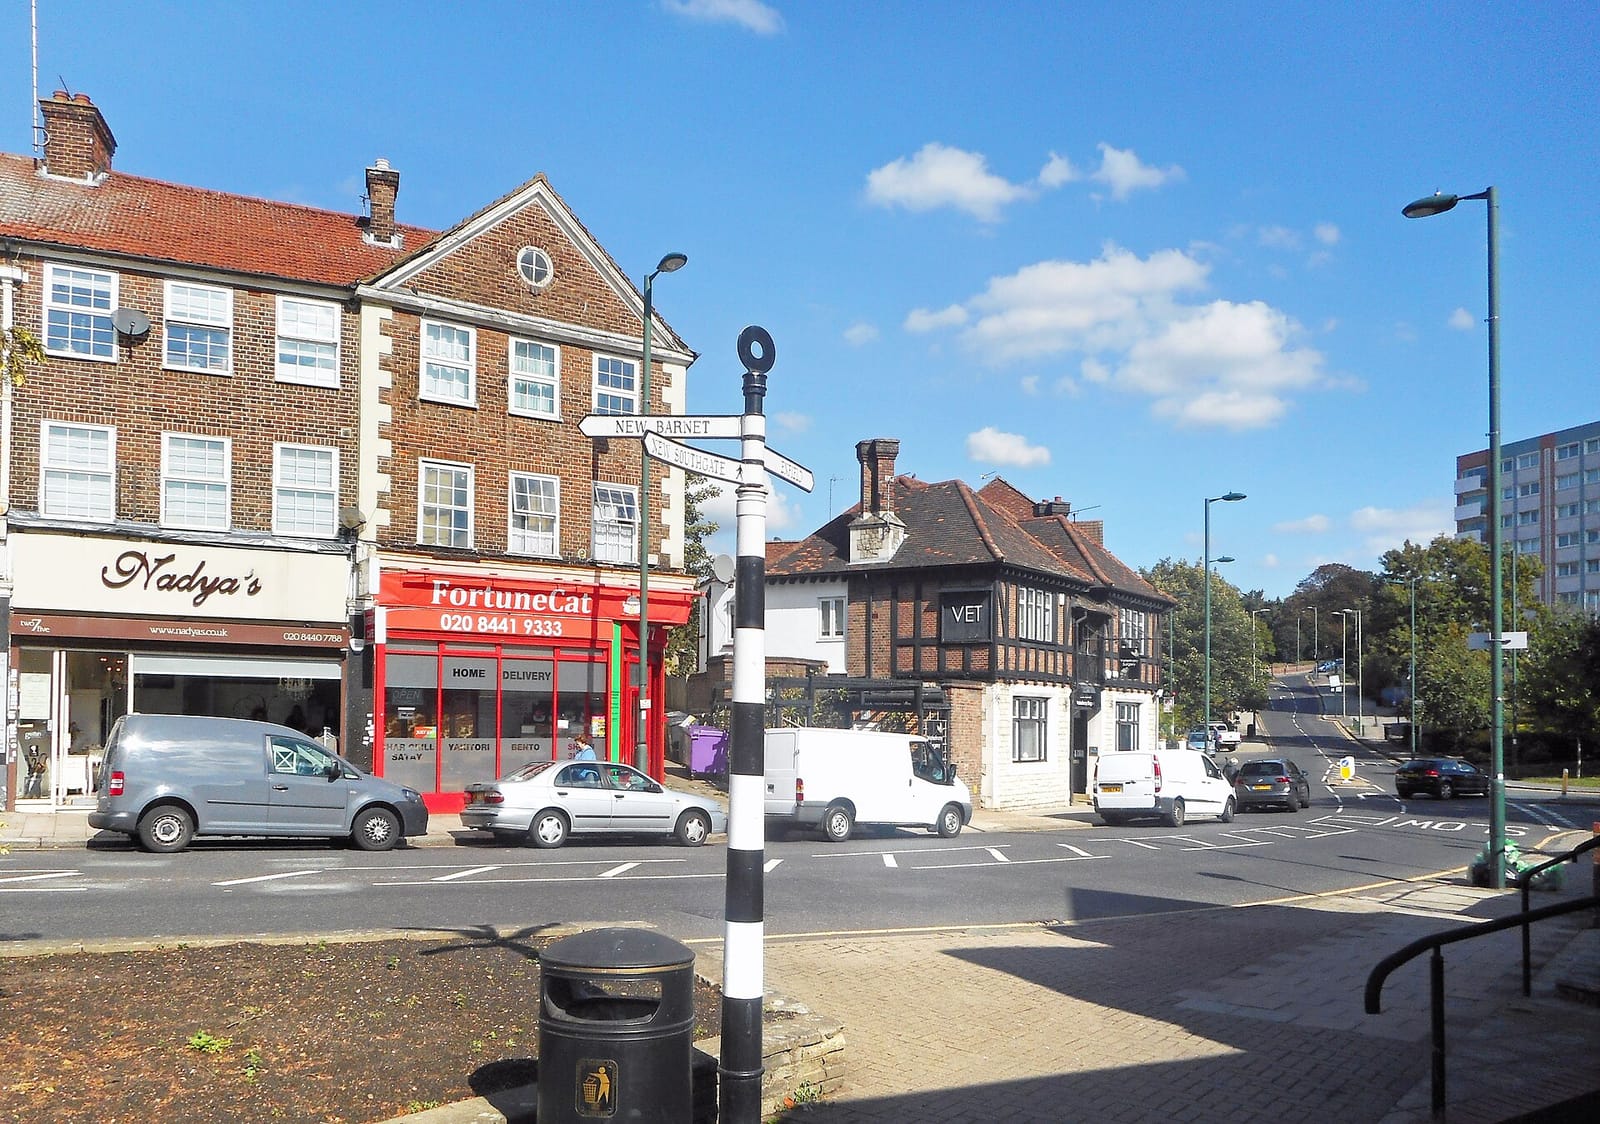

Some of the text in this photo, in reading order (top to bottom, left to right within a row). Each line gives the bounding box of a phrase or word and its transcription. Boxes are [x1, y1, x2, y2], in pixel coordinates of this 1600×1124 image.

[615, 420, 710, 434] NEW BARNET
[651, 437, 726, 476] NEW SOUTHGATE
[780, 460, 804, 484] ENFIELD
[102, 550, 262, 607] Nadya's
[431, 580, 592, 614] FortuneCat
[951, 604, 983, 622] VET
[149, 625, 228, 638] www.nadyas.co.uk
[440, 613, 562, 637] 020 8441 9333
[283, 632, 342, 643] 020 8440 7788
[452, 668, 552, 681] HOME DELIVERY
[391, 689, 420, 700] OPEN
[511, 743, 540, 751] BENTO
